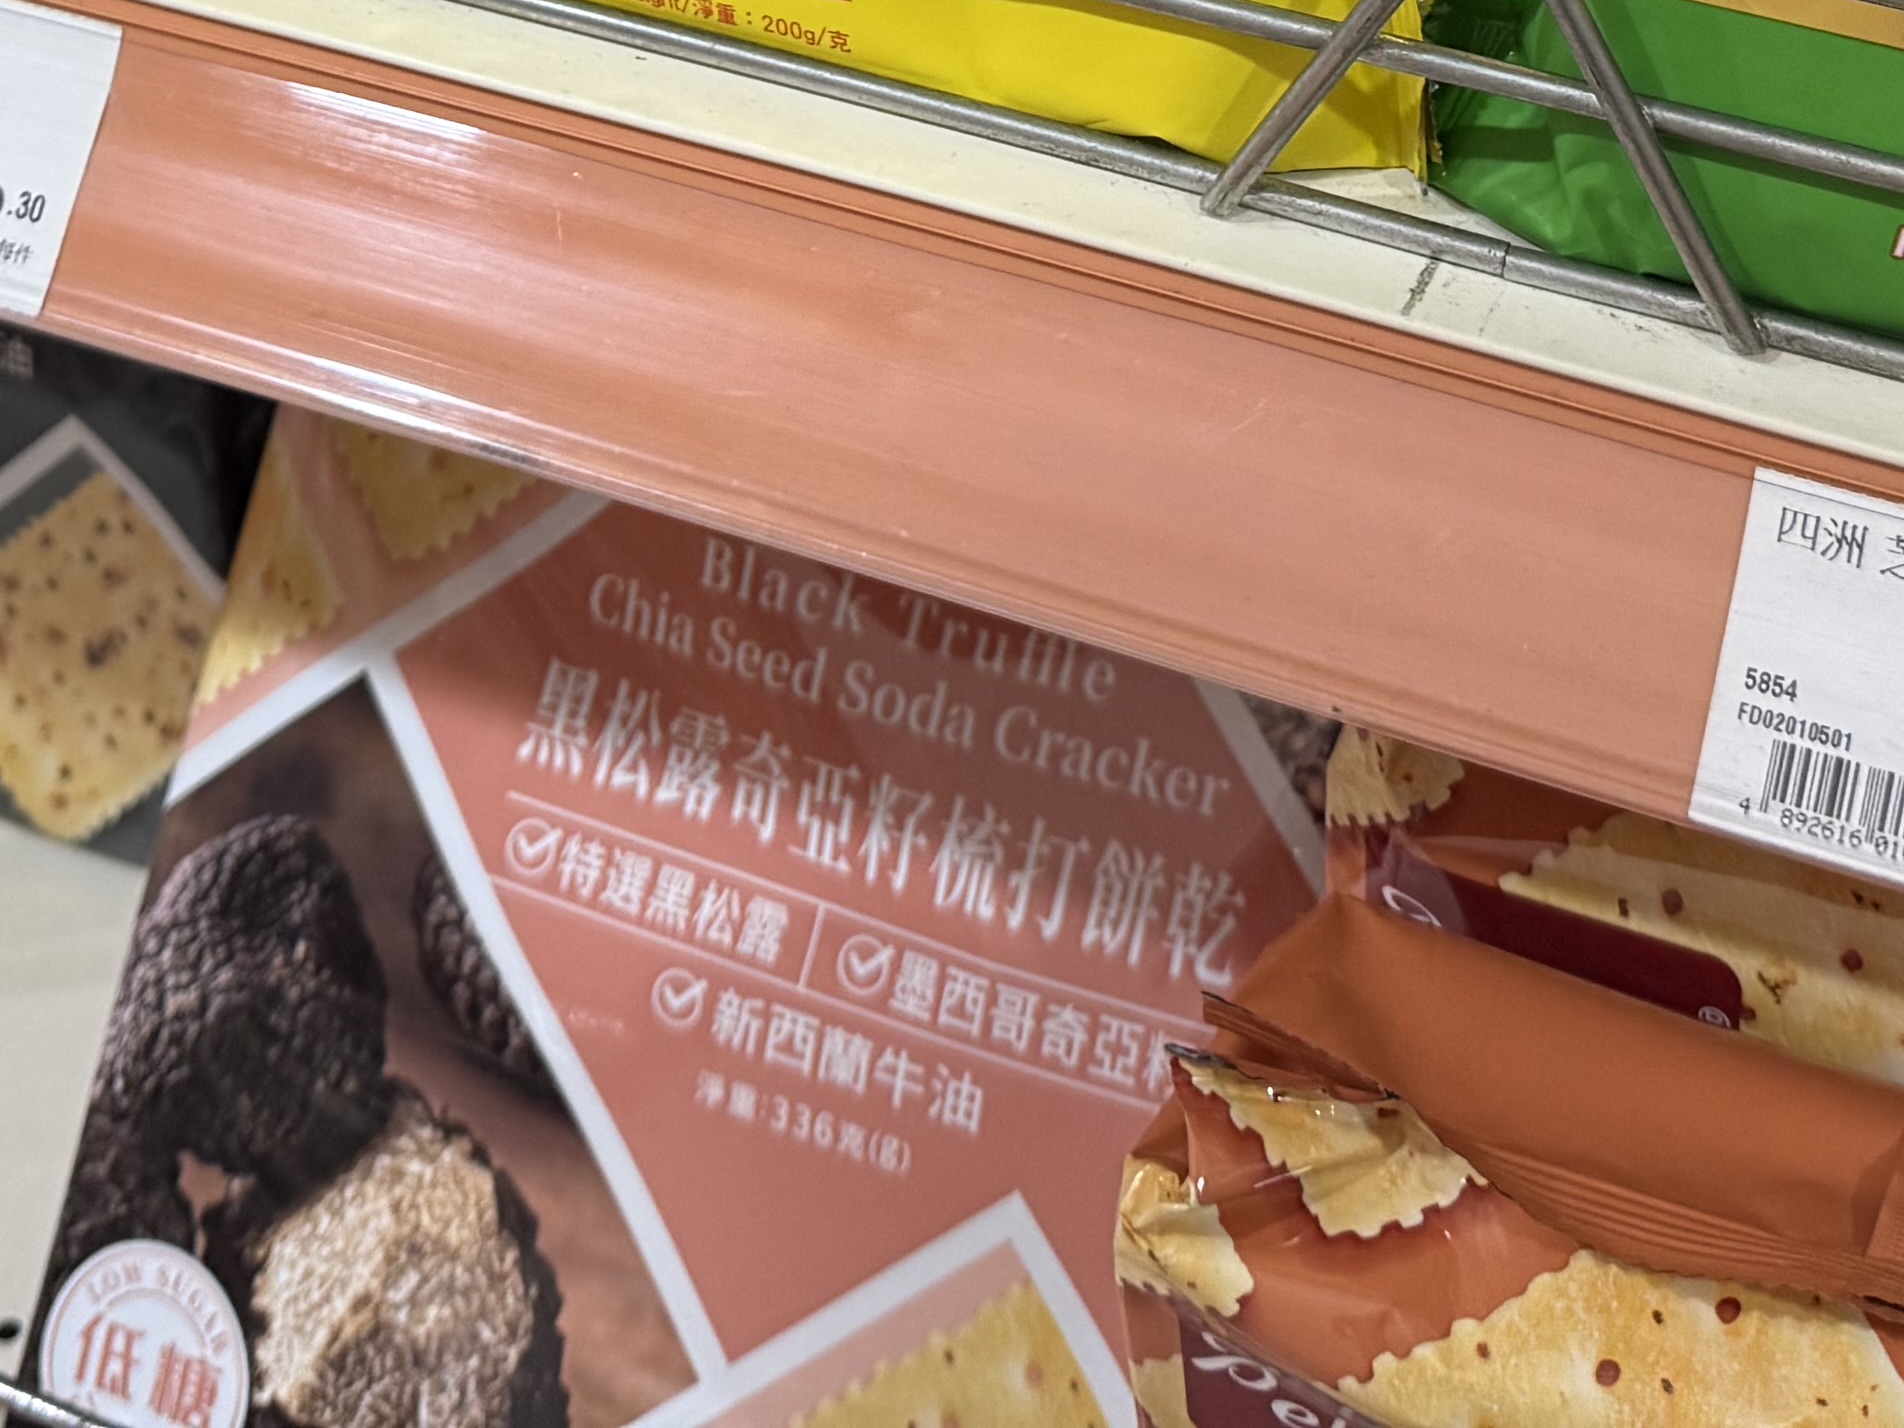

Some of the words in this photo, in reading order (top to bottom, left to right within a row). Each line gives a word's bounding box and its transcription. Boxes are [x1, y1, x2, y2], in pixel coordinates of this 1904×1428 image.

[7, 190, 47, 223] .30
[1775, 504, 1870, 572] 四洲
[700, 534, 872, 635] Black
[899, 594, 1116, 702] Truffle
[587, 570, 698, 659] Chia
[705, 616, 830, 707] Seed
[836, 658, 975, 749] Soda
[994, 706, 1231, 820] Cracker
[1736, 700, 1854, 753] FD02010501
[1743, 666, 1800, 704] 5854
[515, 655, 1250, 988] 黑松露奇亞籽梳打餅乾
[1737, 794, 1752, 817] 4
[557, 829, 793, 968] 特選黑松露
[711, 987, 986, 1137] 新西蘭牛油
[74, 1313, 224, 1428] 低糖
